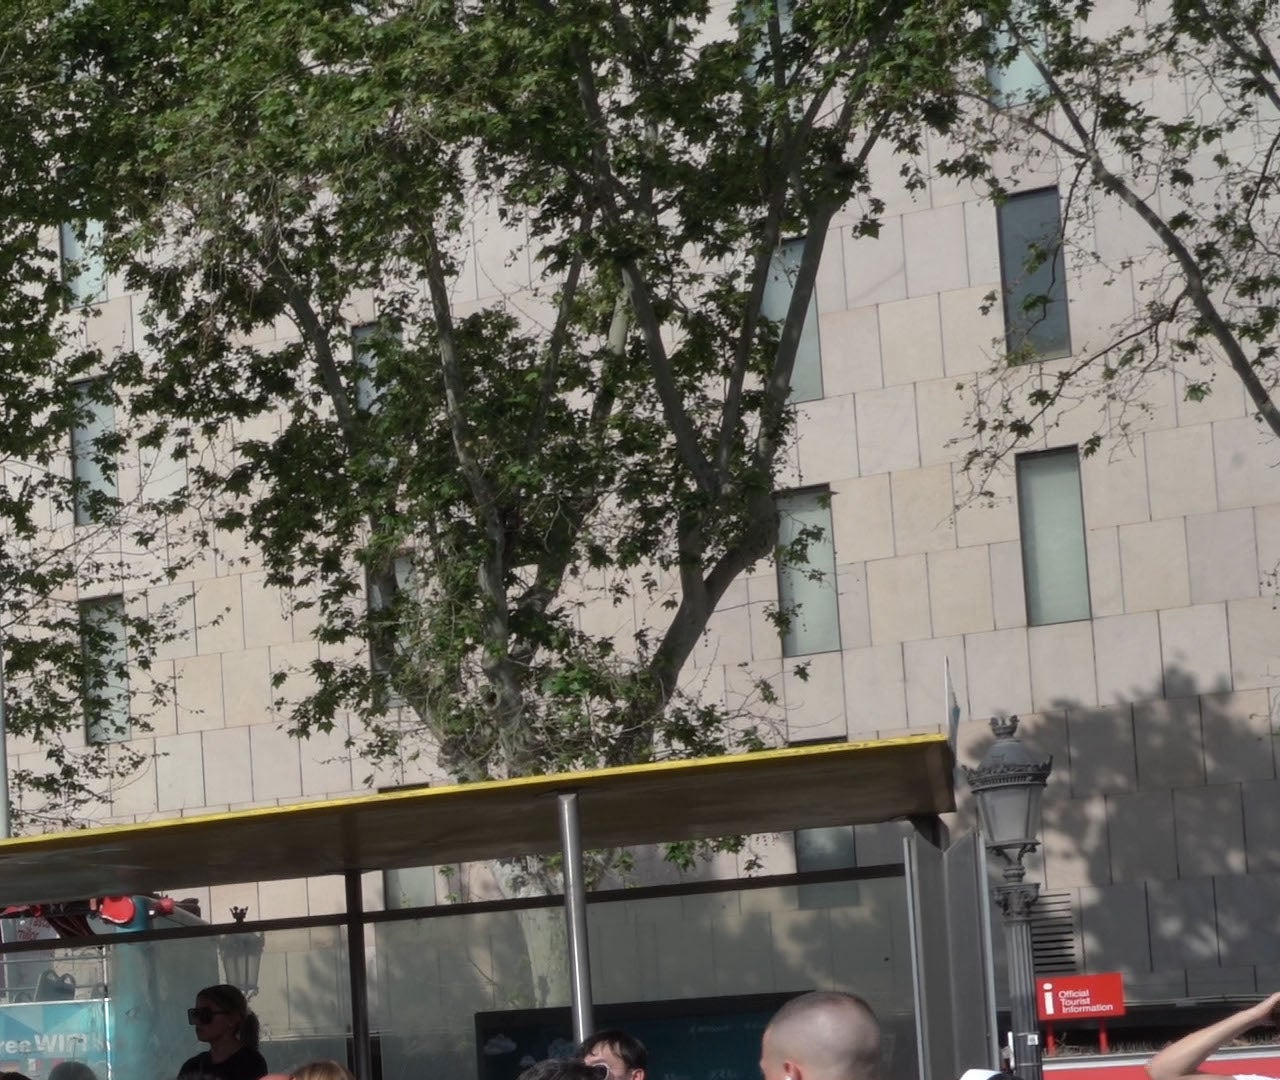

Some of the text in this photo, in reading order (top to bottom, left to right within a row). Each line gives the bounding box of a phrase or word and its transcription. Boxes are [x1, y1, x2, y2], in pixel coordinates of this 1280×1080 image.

[1058, 989, 1090, 999] Official
[1060, 998, 1091, 1006] Tourist
[1062, 1004, 1114, 1014] Information
